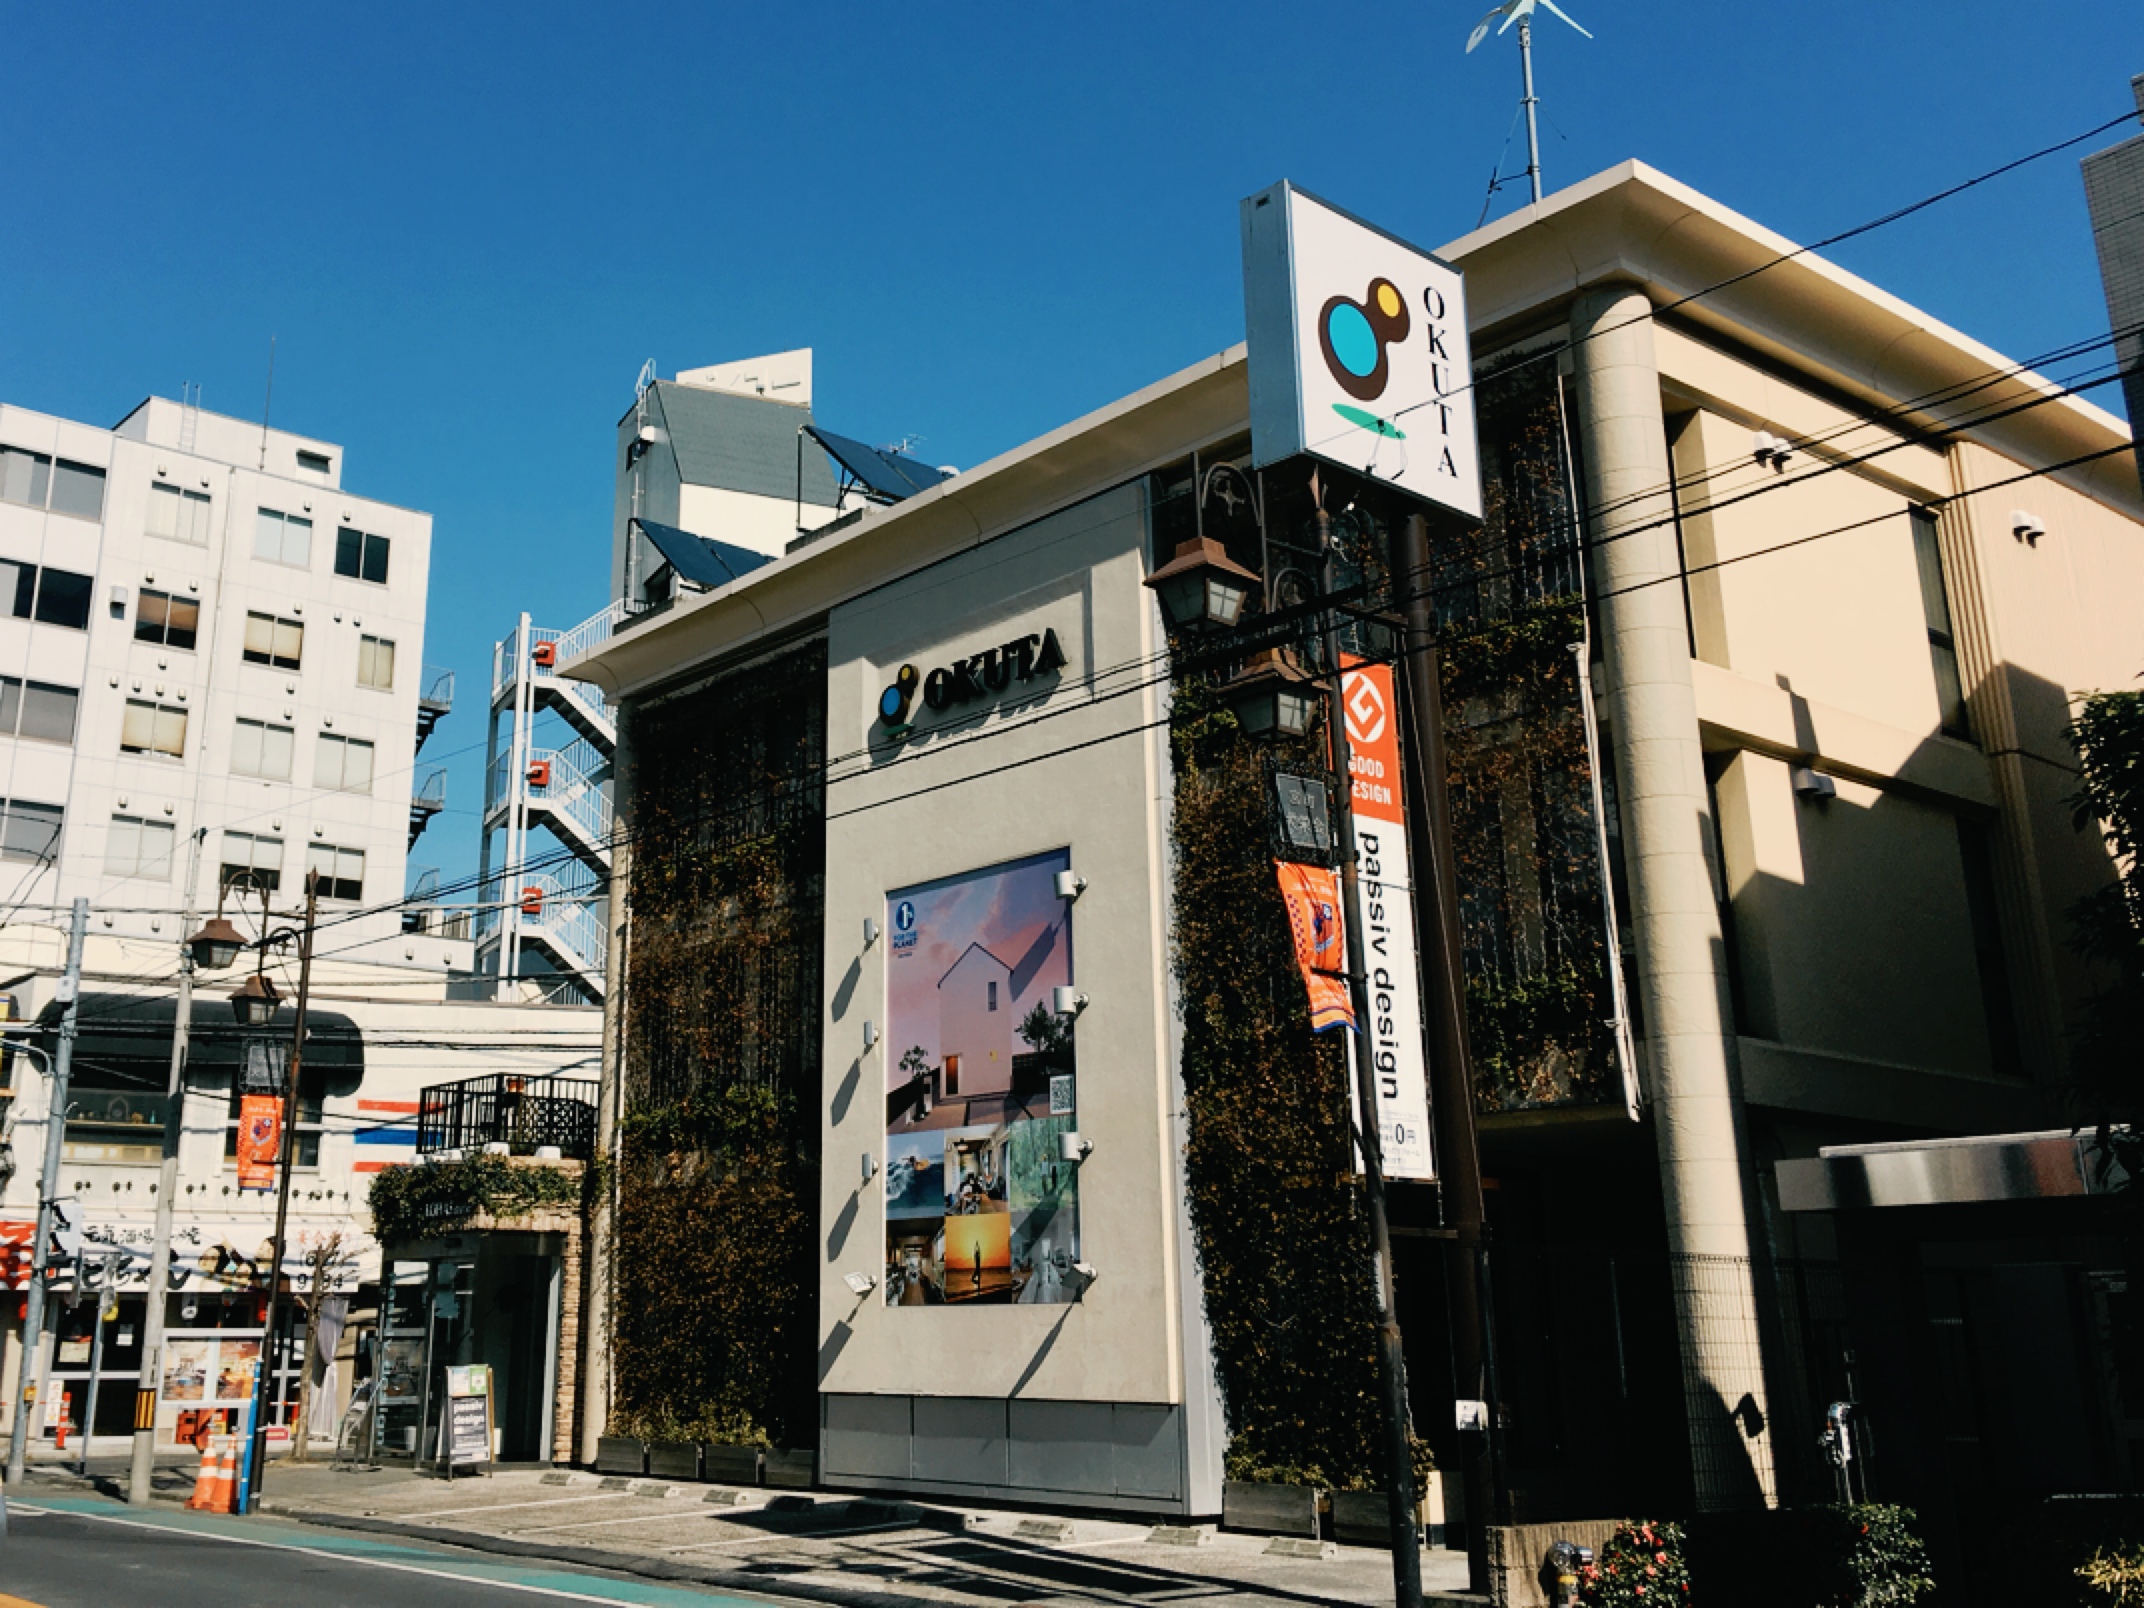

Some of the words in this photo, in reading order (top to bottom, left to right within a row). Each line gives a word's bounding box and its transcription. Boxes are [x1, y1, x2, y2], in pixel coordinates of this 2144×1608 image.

[1423, 285, 1458, 479] OKUTA
[923, 627, 1069, 710] OKUTA
[1352, 781, 1392, 805] ESIGN
[1358, 831, 1390, 957] passiv
[1373, 967, 1399, 1099] design
